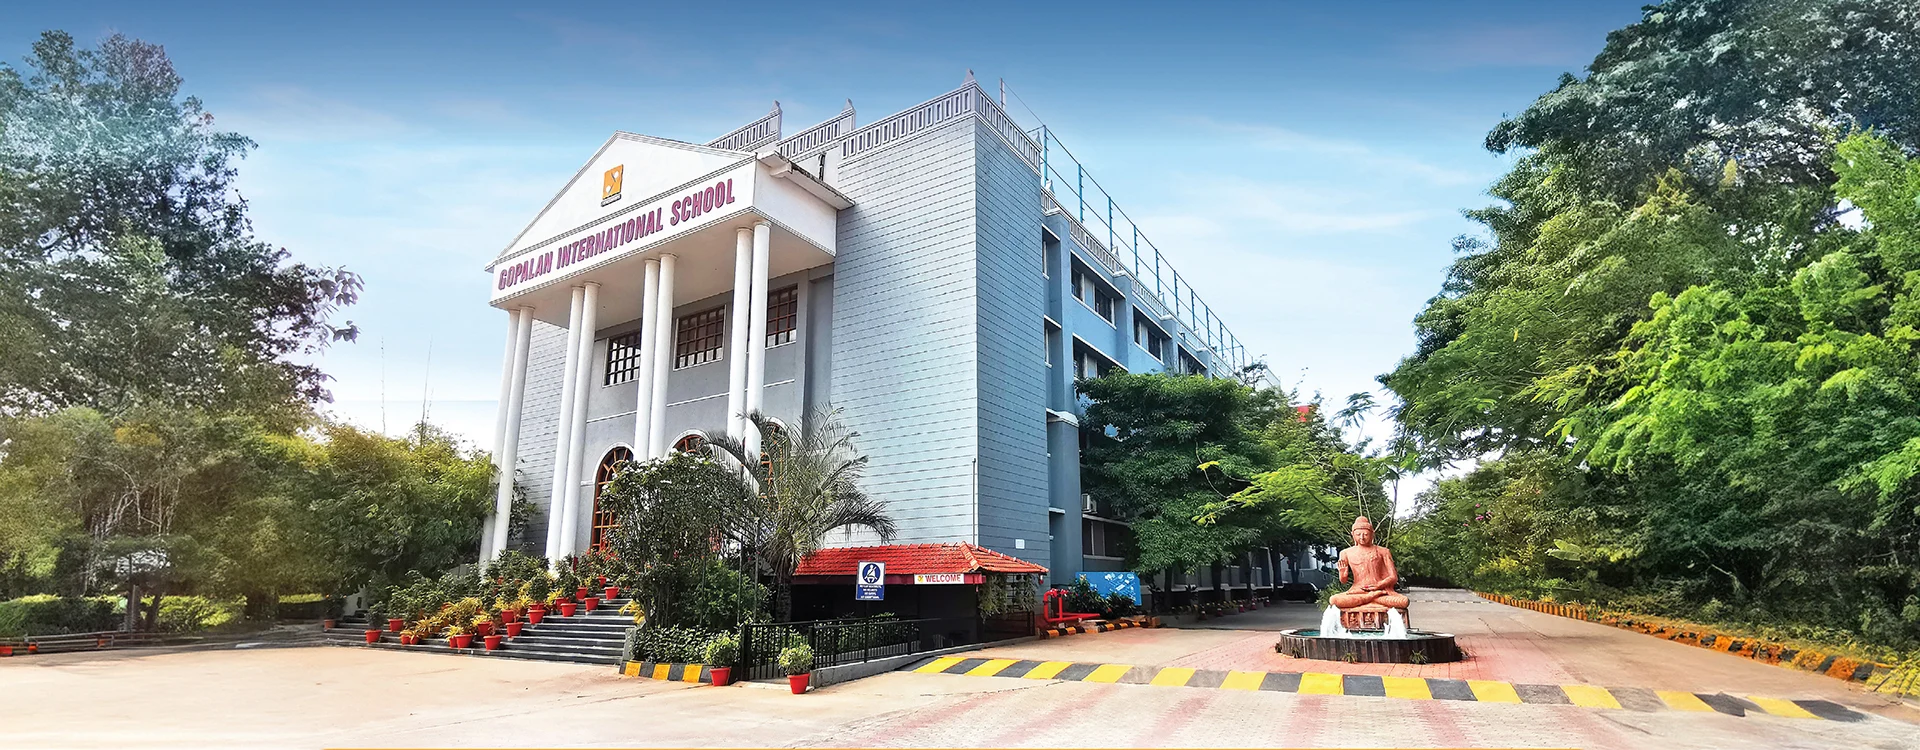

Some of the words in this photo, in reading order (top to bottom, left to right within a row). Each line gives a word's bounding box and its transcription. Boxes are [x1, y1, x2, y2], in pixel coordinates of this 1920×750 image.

[498, 251, 553, 290] GOPALAN
[556, 207, 663, 269] INTERNATIONAL
[670, 178, 735, 226] SCHOOL
[925, 574, 961, 582] WELCOME
